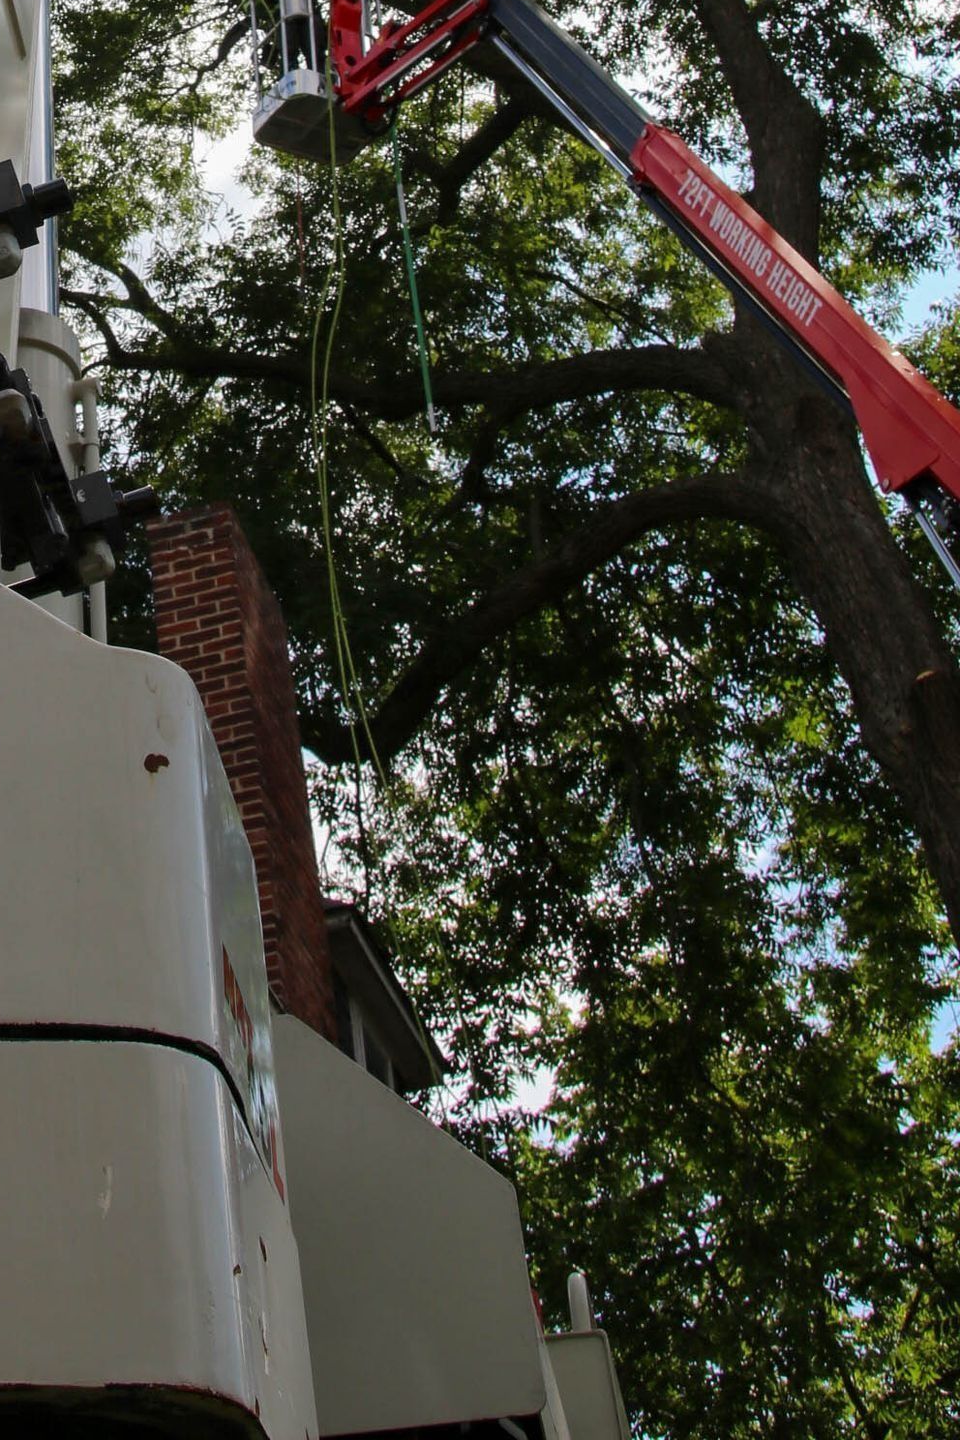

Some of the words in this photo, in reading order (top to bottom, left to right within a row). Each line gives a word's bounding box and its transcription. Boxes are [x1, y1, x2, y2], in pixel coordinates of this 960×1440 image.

[677, 170, 714, 216] 72FT
[709, 201, 772, 276] WORKING
[766, 261, 823, 326] HEIGHT
